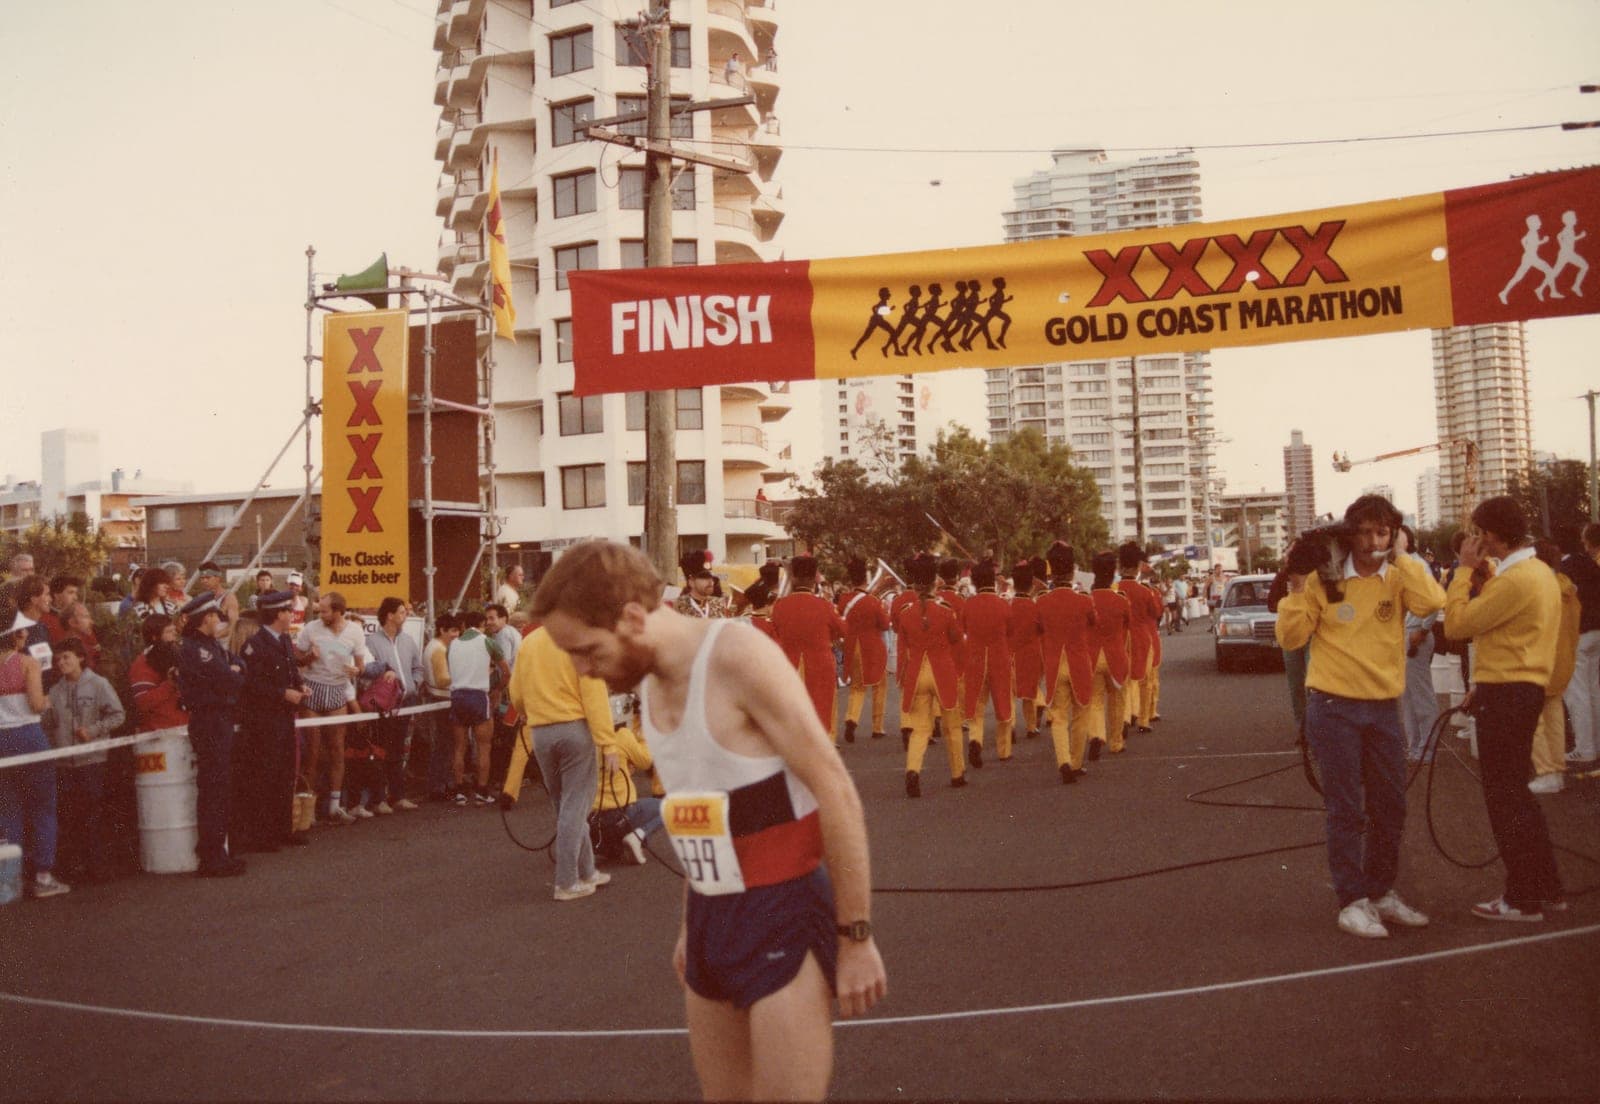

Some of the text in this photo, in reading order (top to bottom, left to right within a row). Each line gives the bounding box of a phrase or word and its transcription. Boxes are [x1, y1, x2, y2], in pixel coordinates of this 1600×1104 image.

[1082, 219, 1350, 308] XXXX
[611, 294, 772, 355] FINISH
[1045, 285, 1403, 346] GOLD COAST MARATHON
[346, 327, 384, 533] XXXX
[329, 551, 394, 567] The Classic
[329, 570, 401, 584] Aussie beer
[673, 805, 710, 824] XXXX
